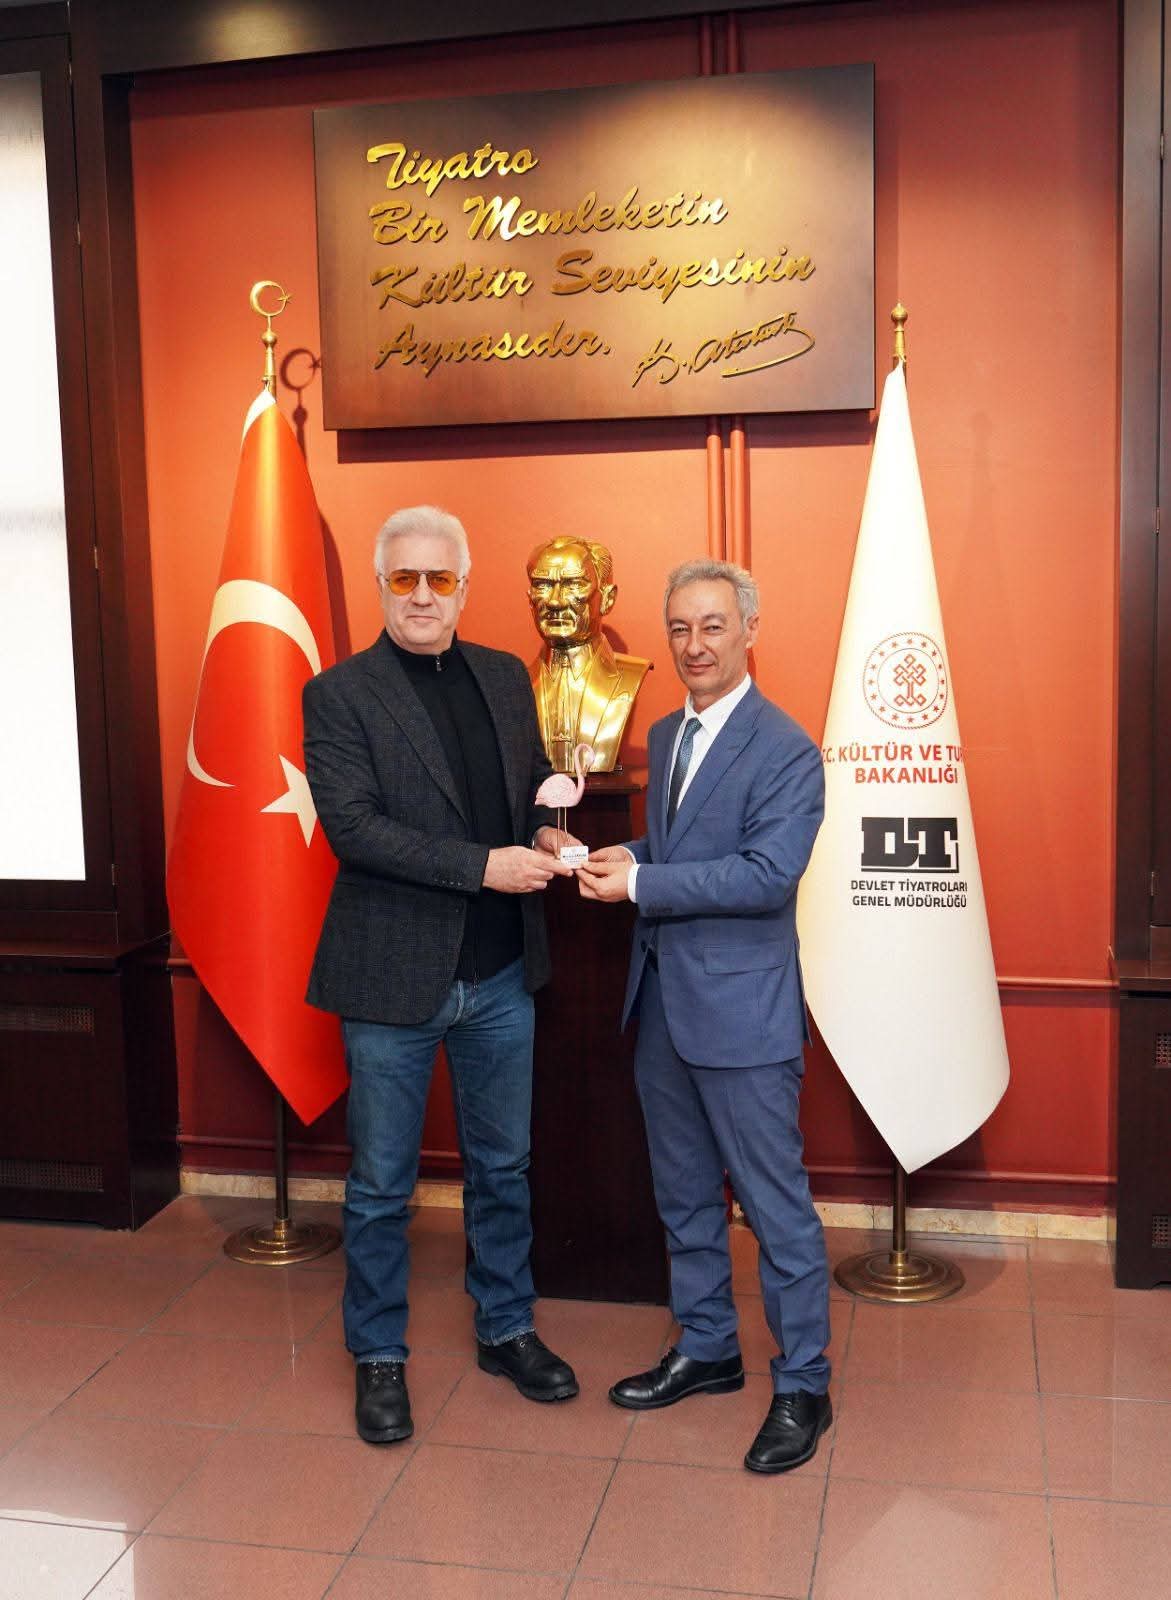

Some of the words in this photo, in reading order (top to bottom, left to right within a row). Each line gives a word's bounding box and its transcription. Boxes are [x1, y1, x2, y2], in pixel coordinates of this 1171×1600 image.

[366, 142, 539, 197] Tiyatro
[368, 200, 448, 245] Bir
[463, 186, 729, 241] Memleketin
[369, 261, 533, 310] Kültür
[550, 247, 817, 303] Seviyesinin
[822, 746, 835, 763] .C.
[838, 741, 913, 762] KÜLTÜR
[919, 744, 942, 761] VE
[855, 763, 958, 784] BAKANLIĞI
[861, 817, 959, 873] DT
[850, 879, 895, 891] DEVLET
[898, 878, 968, 893] TİYATROLARI
[852, 895, 891, 907] GENEL
[894, 894, 967, 908] MÜDÜRLÜĞÜ
